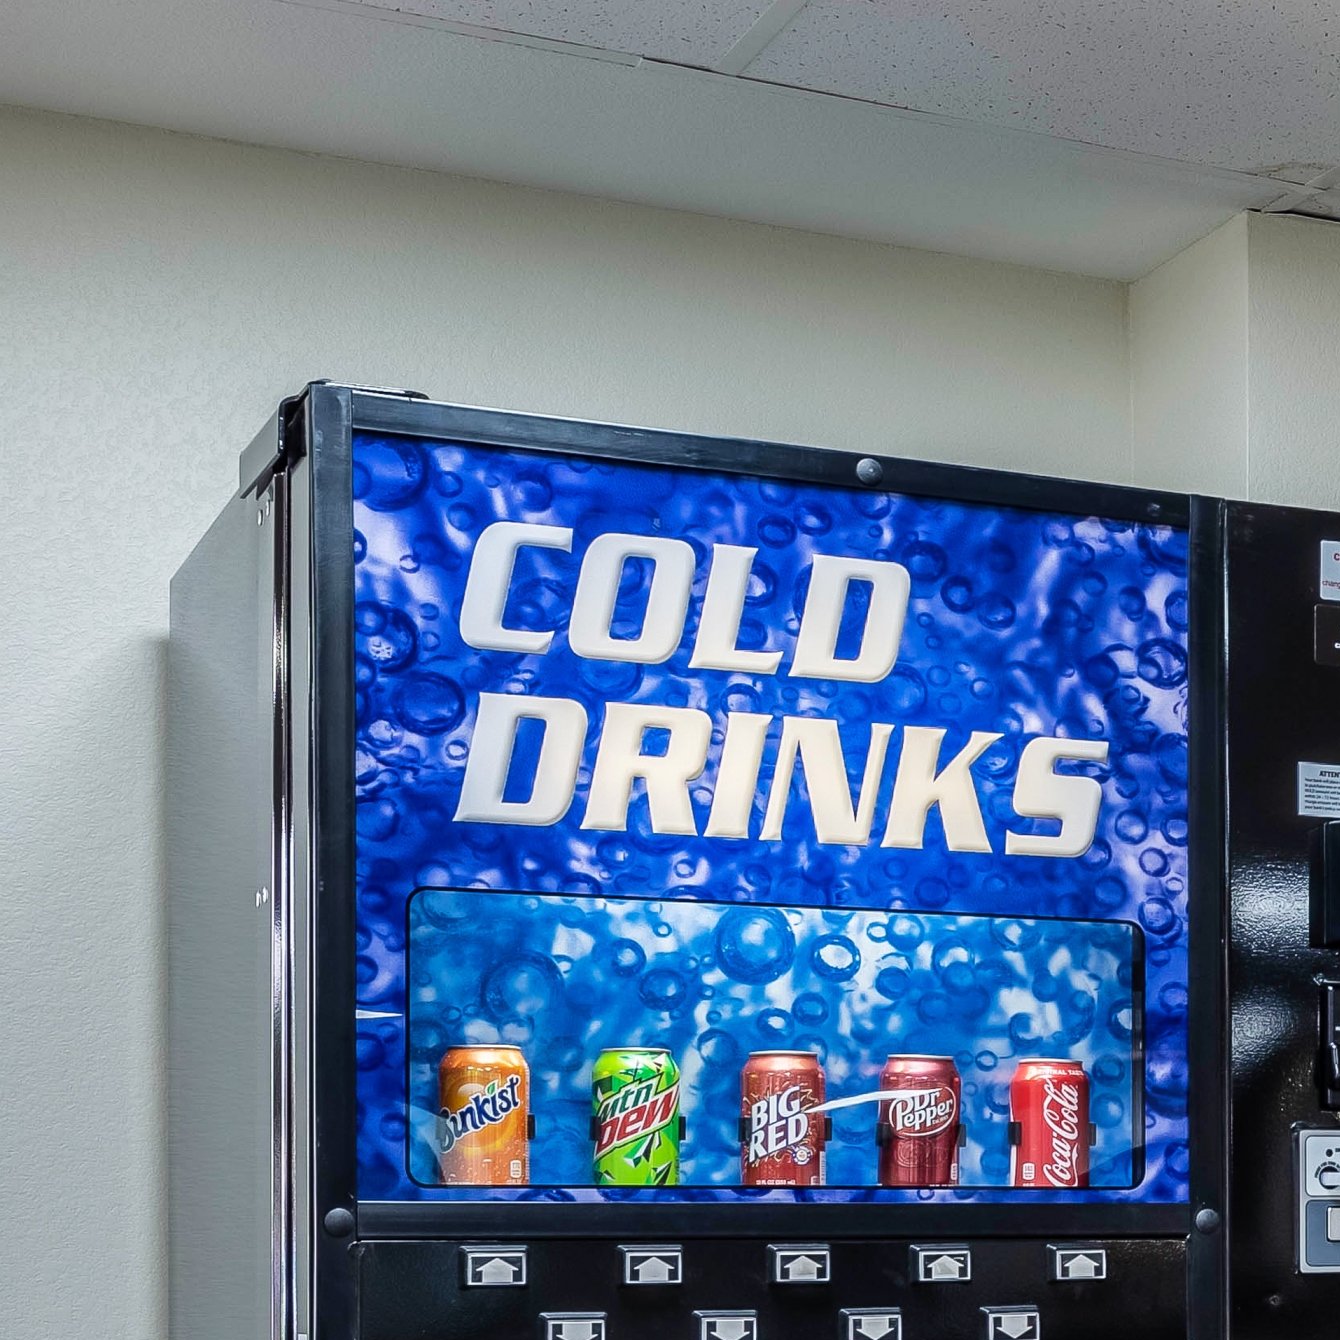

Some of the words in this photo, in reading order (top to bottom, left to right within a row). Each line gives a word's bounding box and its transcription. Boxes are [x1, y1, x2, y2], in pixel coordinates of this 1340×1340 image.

[459, 520, 911, 684] COLD
[453, 691, 1109, 858] DRINKS
[440, 1076, 520, 1153] Sunkist
[752, 1086, 800, 1132] BIG
[896, 1098, 953, 1130] Pepper
[914, 1091, 940, 1110] Dr
[1043, 1077, 1078, 1186] Coca-Cola
[749, 1113, 808, 1163] RED
